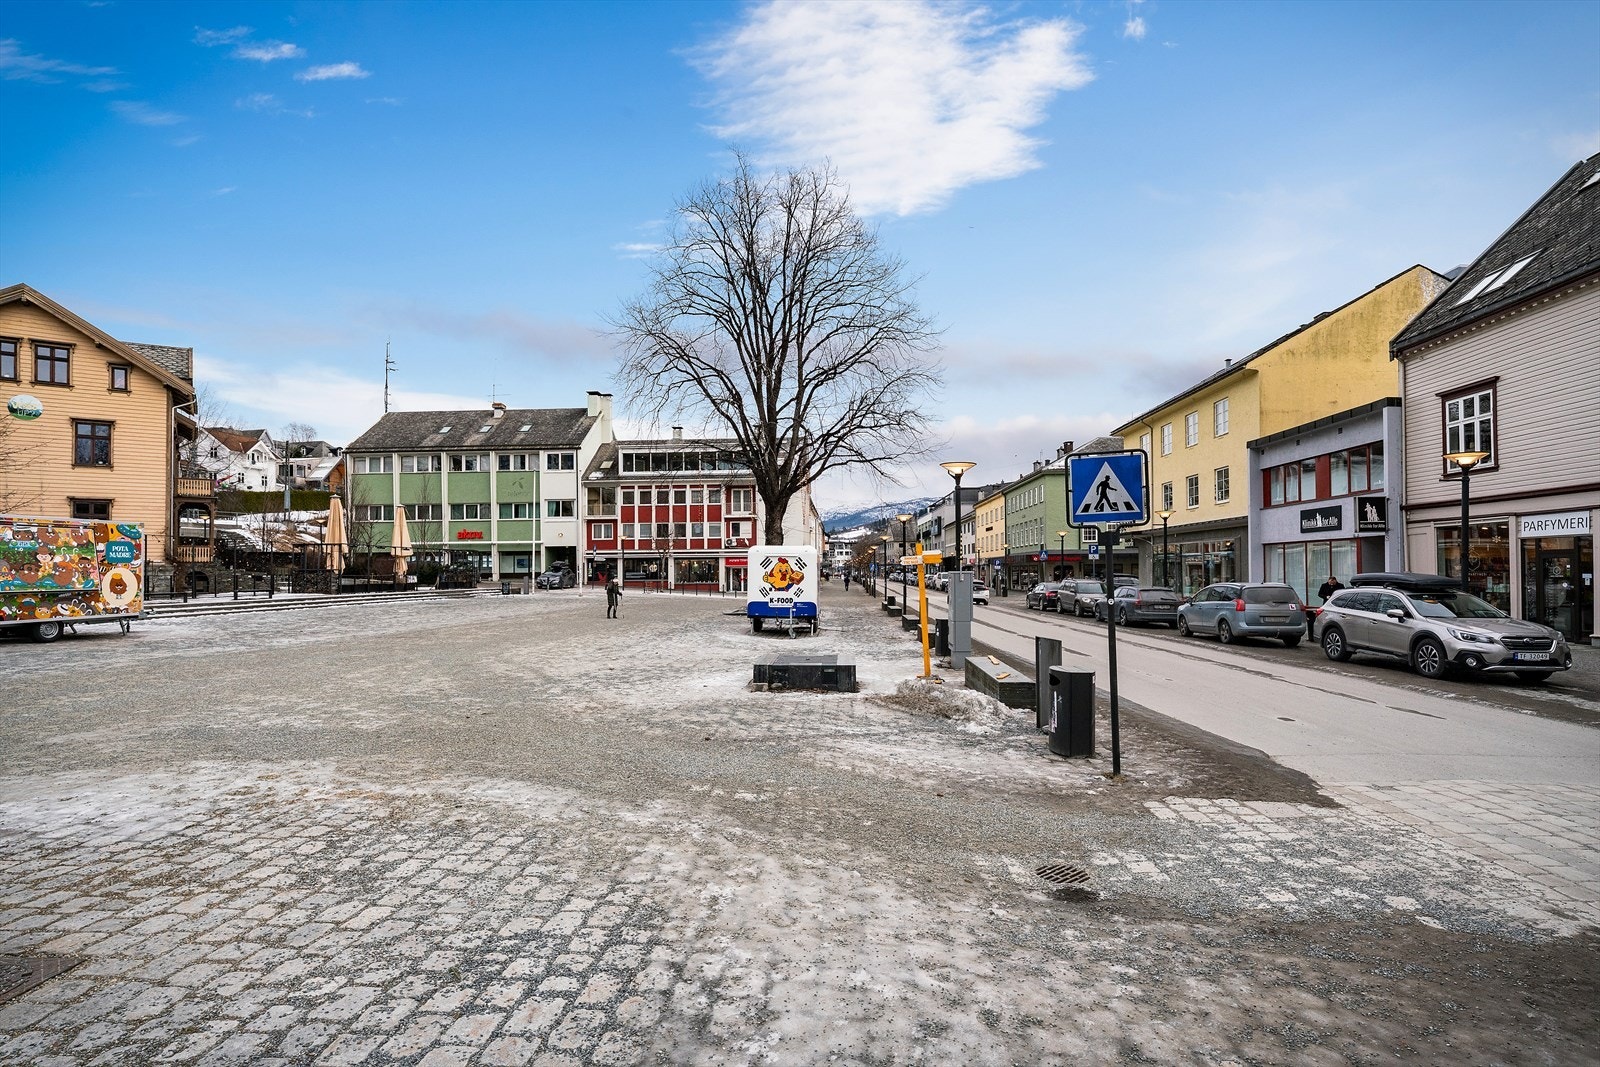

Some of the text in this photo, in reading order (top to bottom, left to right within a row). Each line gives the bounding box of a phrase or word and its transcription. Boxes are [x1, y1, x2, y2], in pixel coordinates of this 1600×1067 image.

[1302, 518, 1317, 528] Klinikk
[1329, 516, 1338, 526] Alle
[1523, 516, 1588, 532] PARFYMERI
[1090, 545, 1097, 553] P
